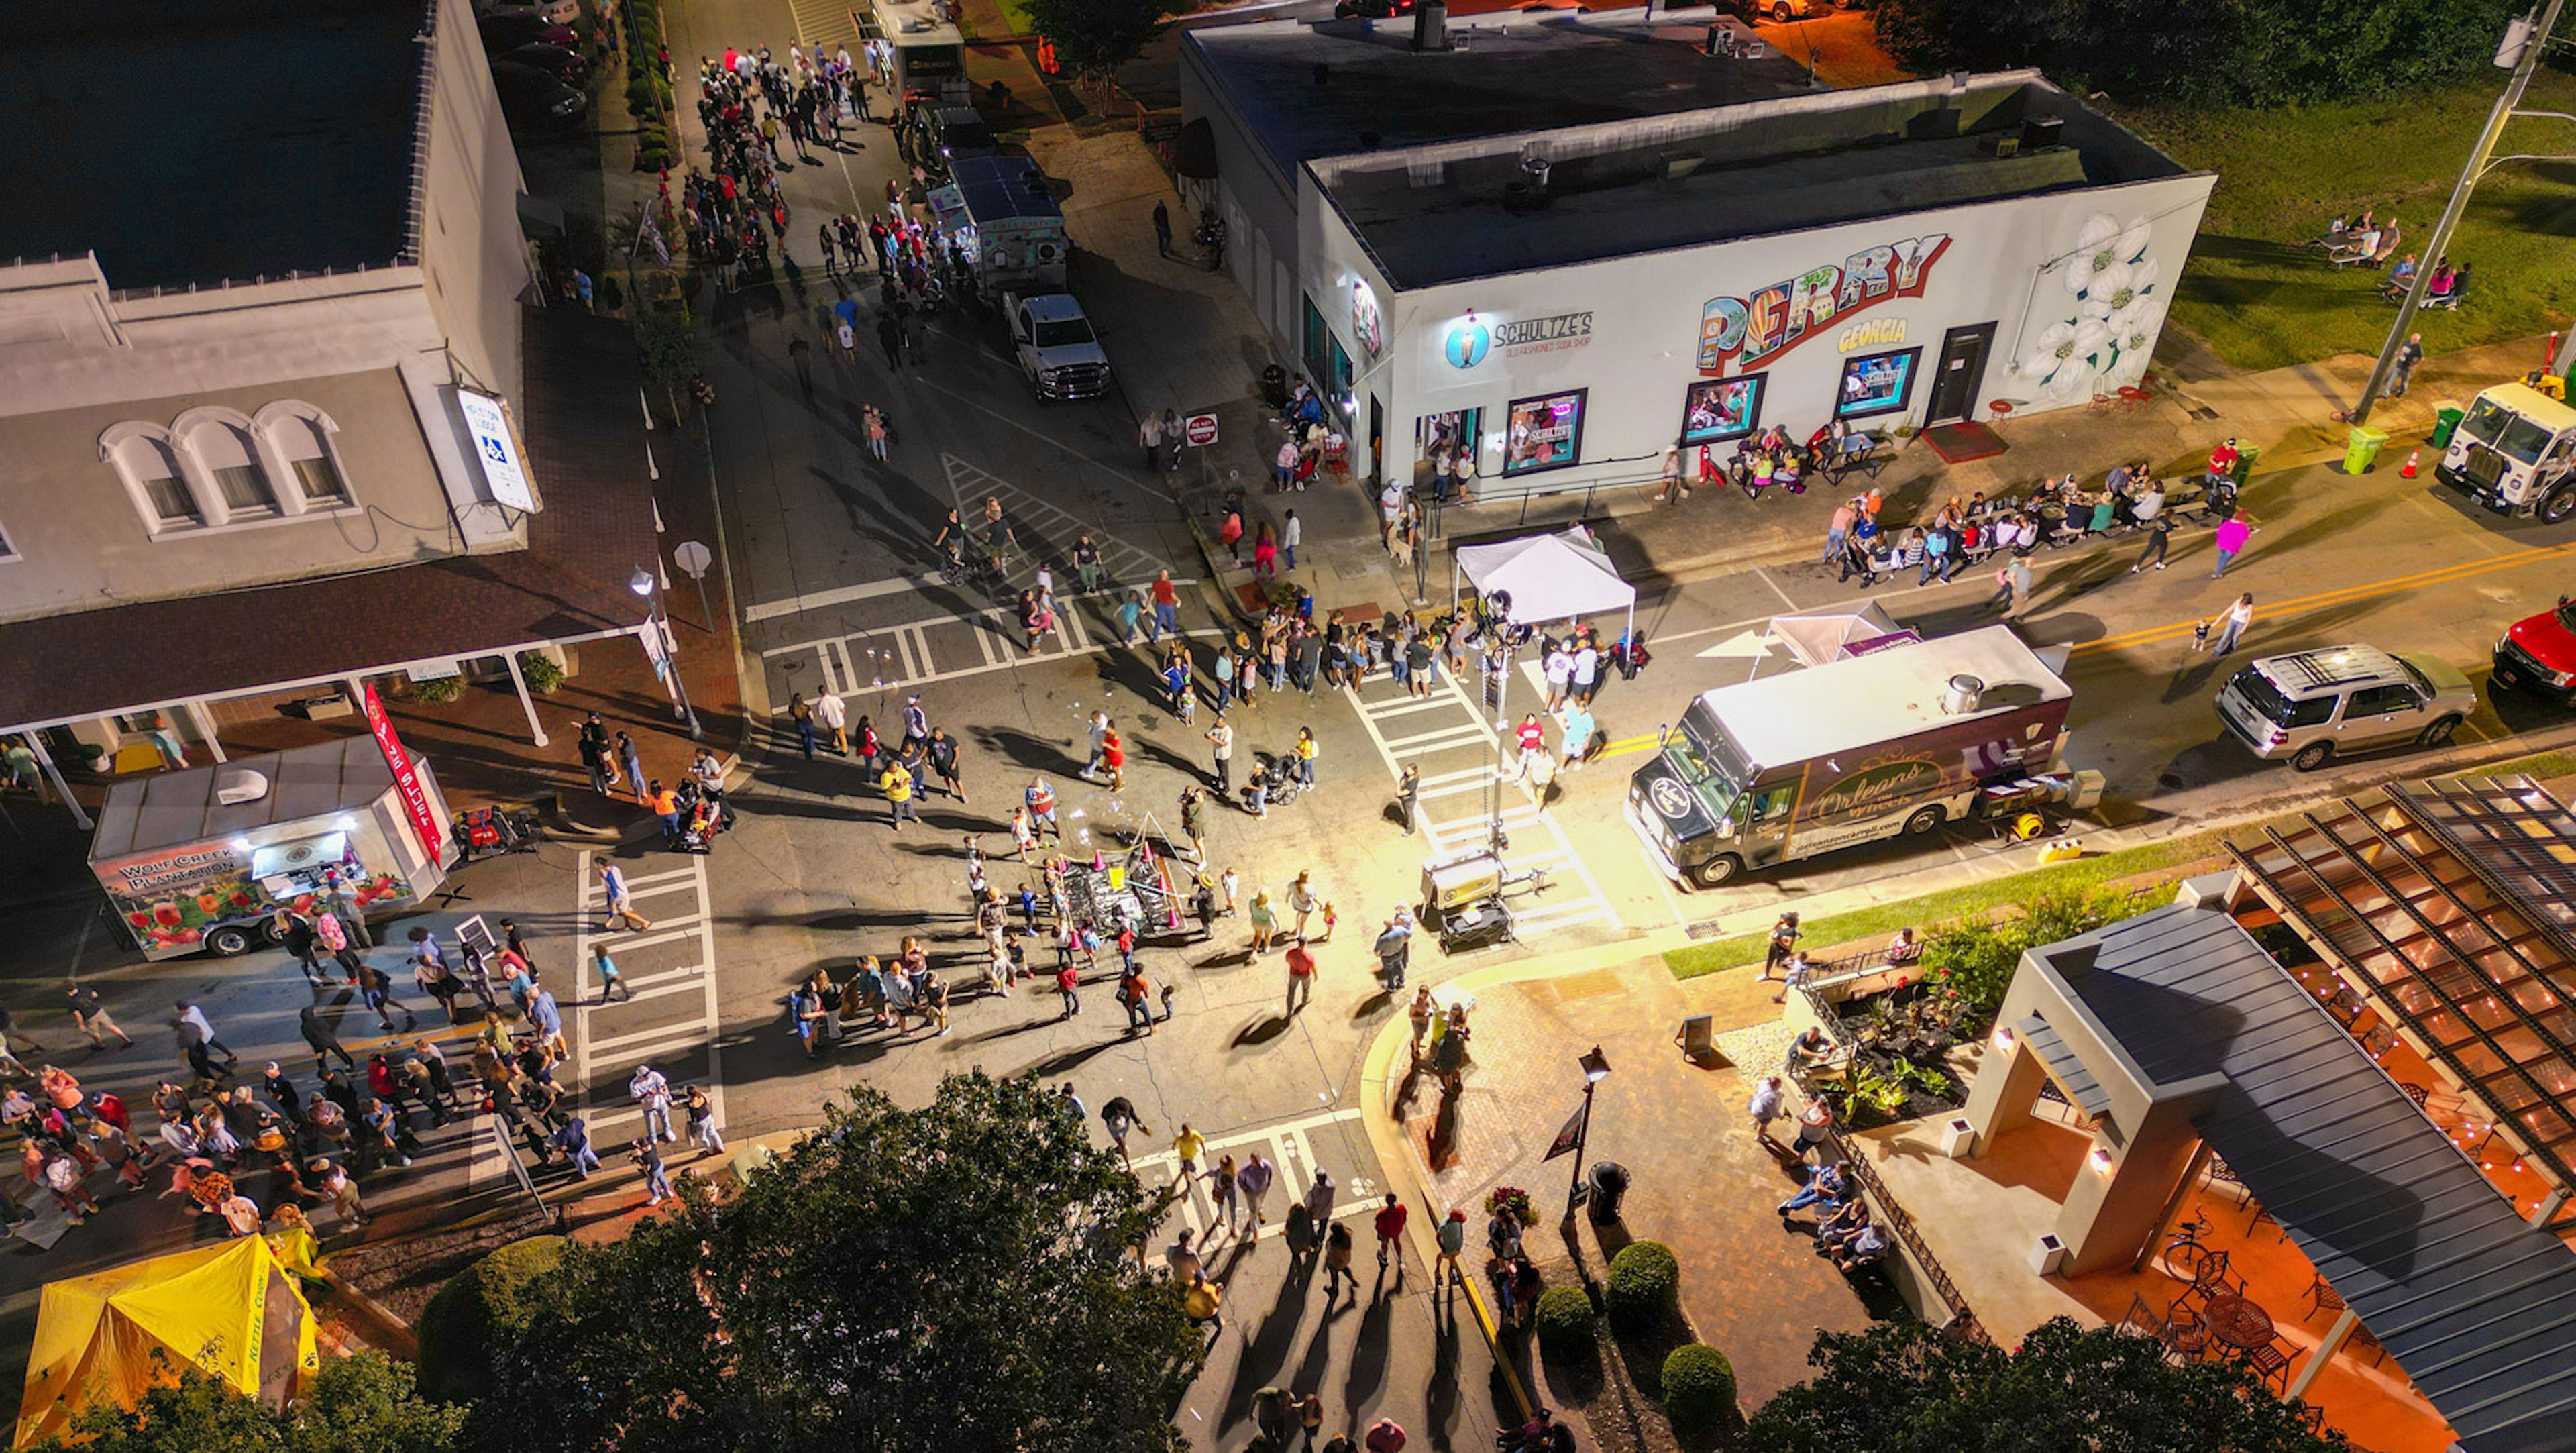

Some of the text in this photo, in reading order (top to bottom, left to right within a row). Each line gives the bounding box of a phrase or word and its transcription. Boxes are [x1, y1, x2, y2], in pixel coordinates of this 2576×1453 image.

[1697, 233, 1951, 374] PERRY
[1495, 311, 1594, 348] SCHULTZE'S
[1838, 318, 1907, 353] GEORGIA
[1507, 336, 1591, 358] OLD FASHIONED SODA SHOP
[1193, 433, 1211, 441] ENTER
[1817, 763, 1924, 820] Orleans
[1849, 796, 1912, 818] WHEELS
[120, 848, 235, 879] WOLF CREEK
[128, 861, 235, 890] PLANTATION
[249, 1275, 264, 1363] KETTLE CORN
